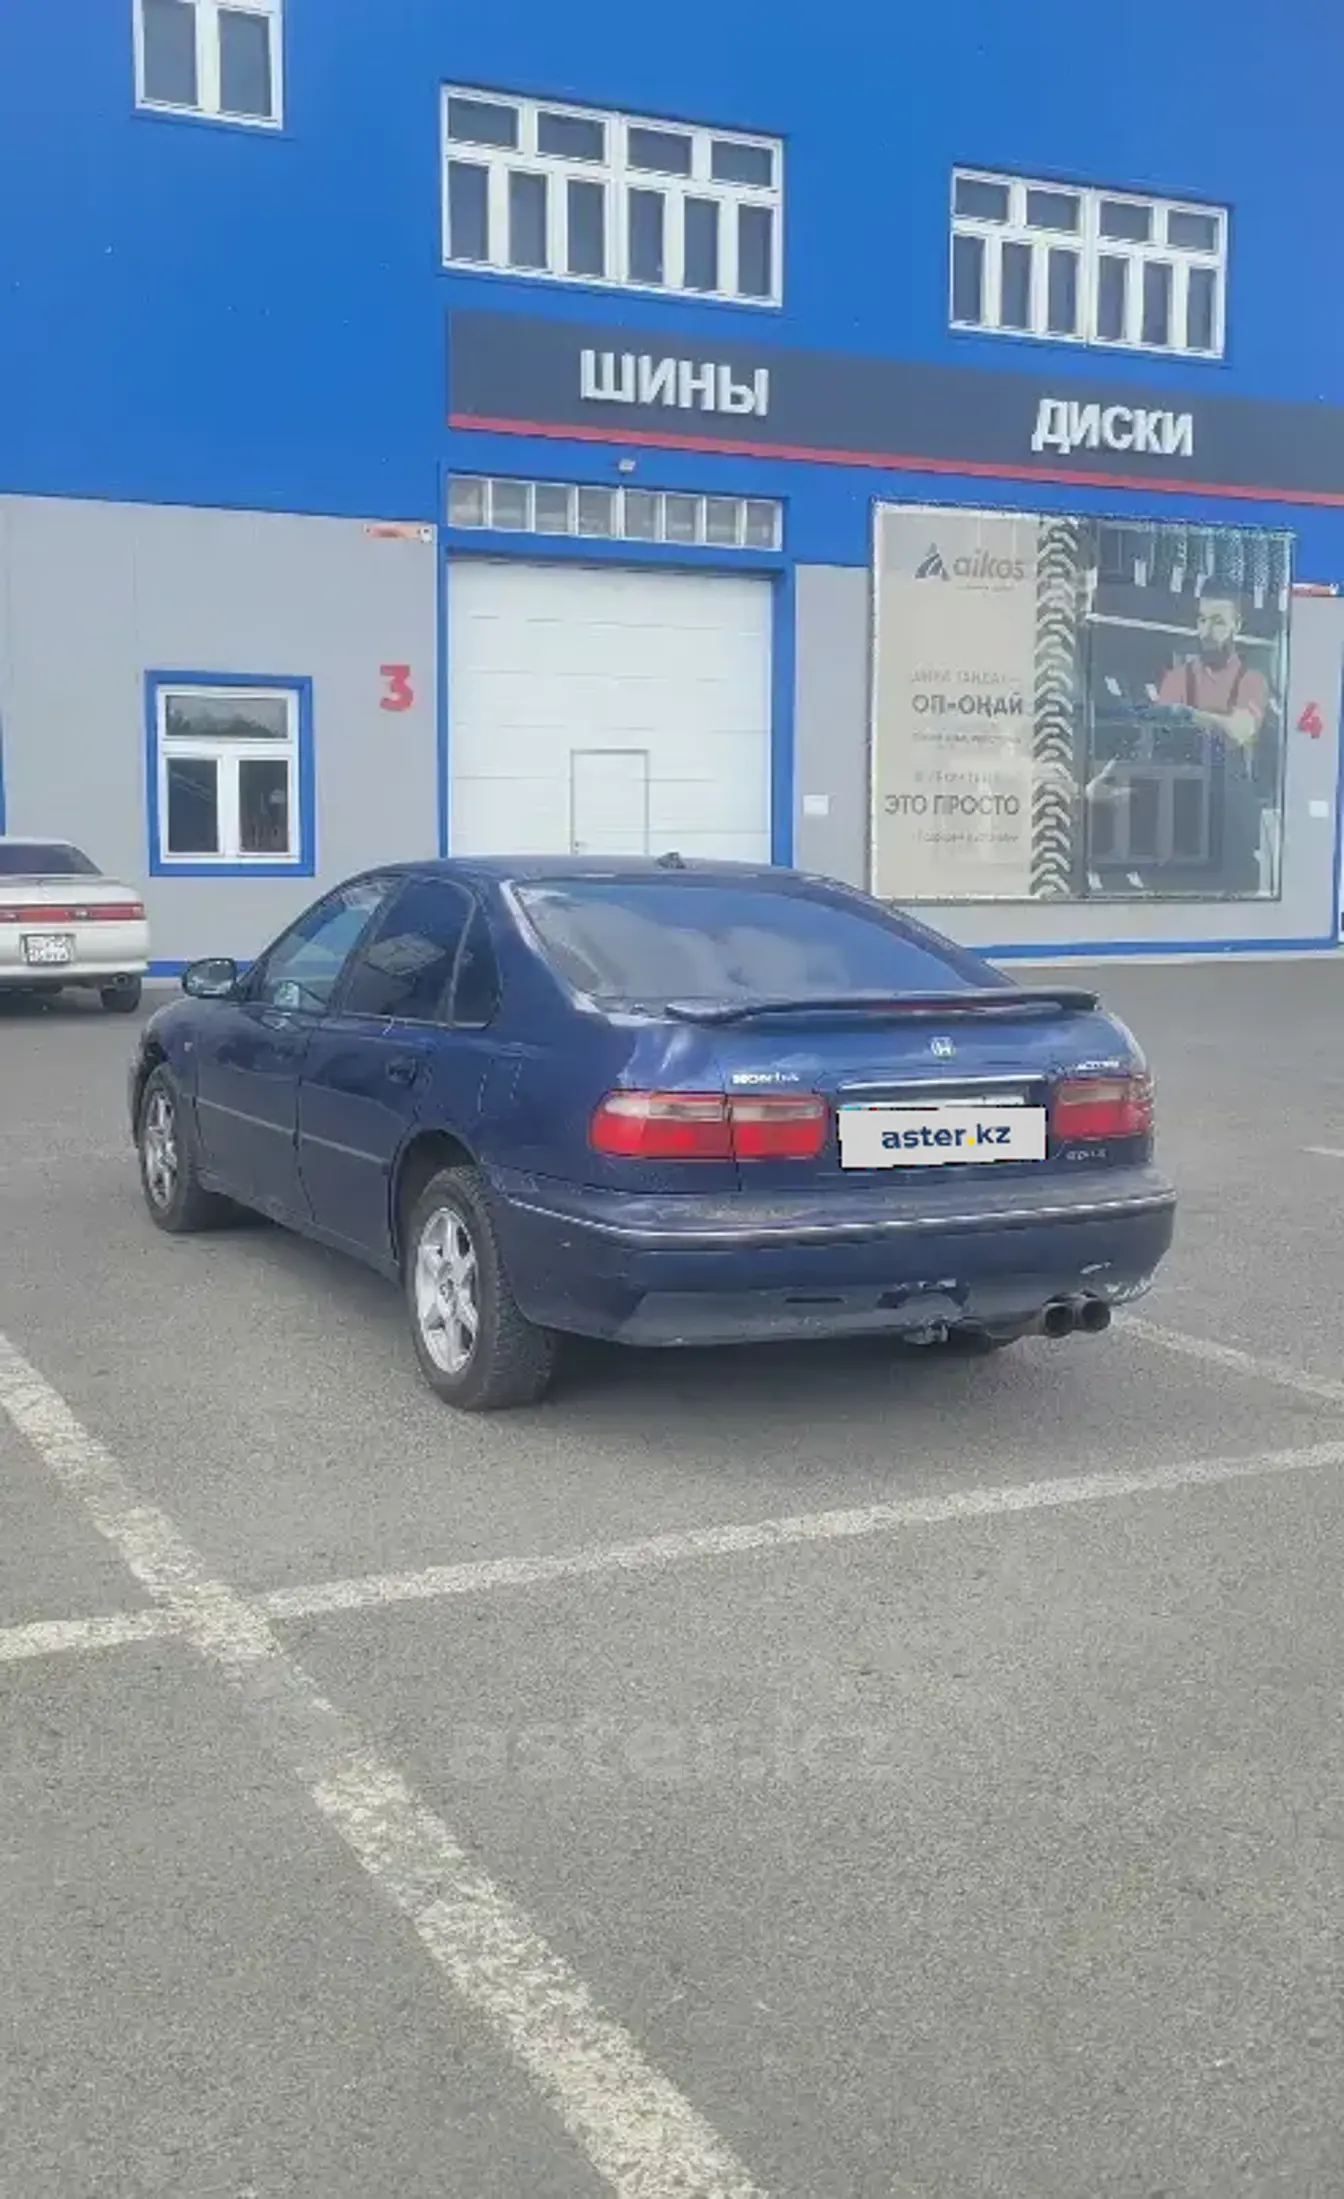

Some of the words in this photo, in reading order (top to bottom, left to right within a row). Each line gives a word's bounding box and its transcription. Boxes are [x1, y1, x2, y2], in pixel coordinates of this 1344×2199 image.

[580, 349, 769, 417] ШИНЫ
[1031, 398, 1193, 457] ДИСКИ
[953, 549, 1025, 580] aikos
[379, 665, 414, 712] 3
[1298, 702, 1323, 739] 4
[885, 794, 928, 815] ЭТО
[933, 794, 1020, 815] ПРОСТО
